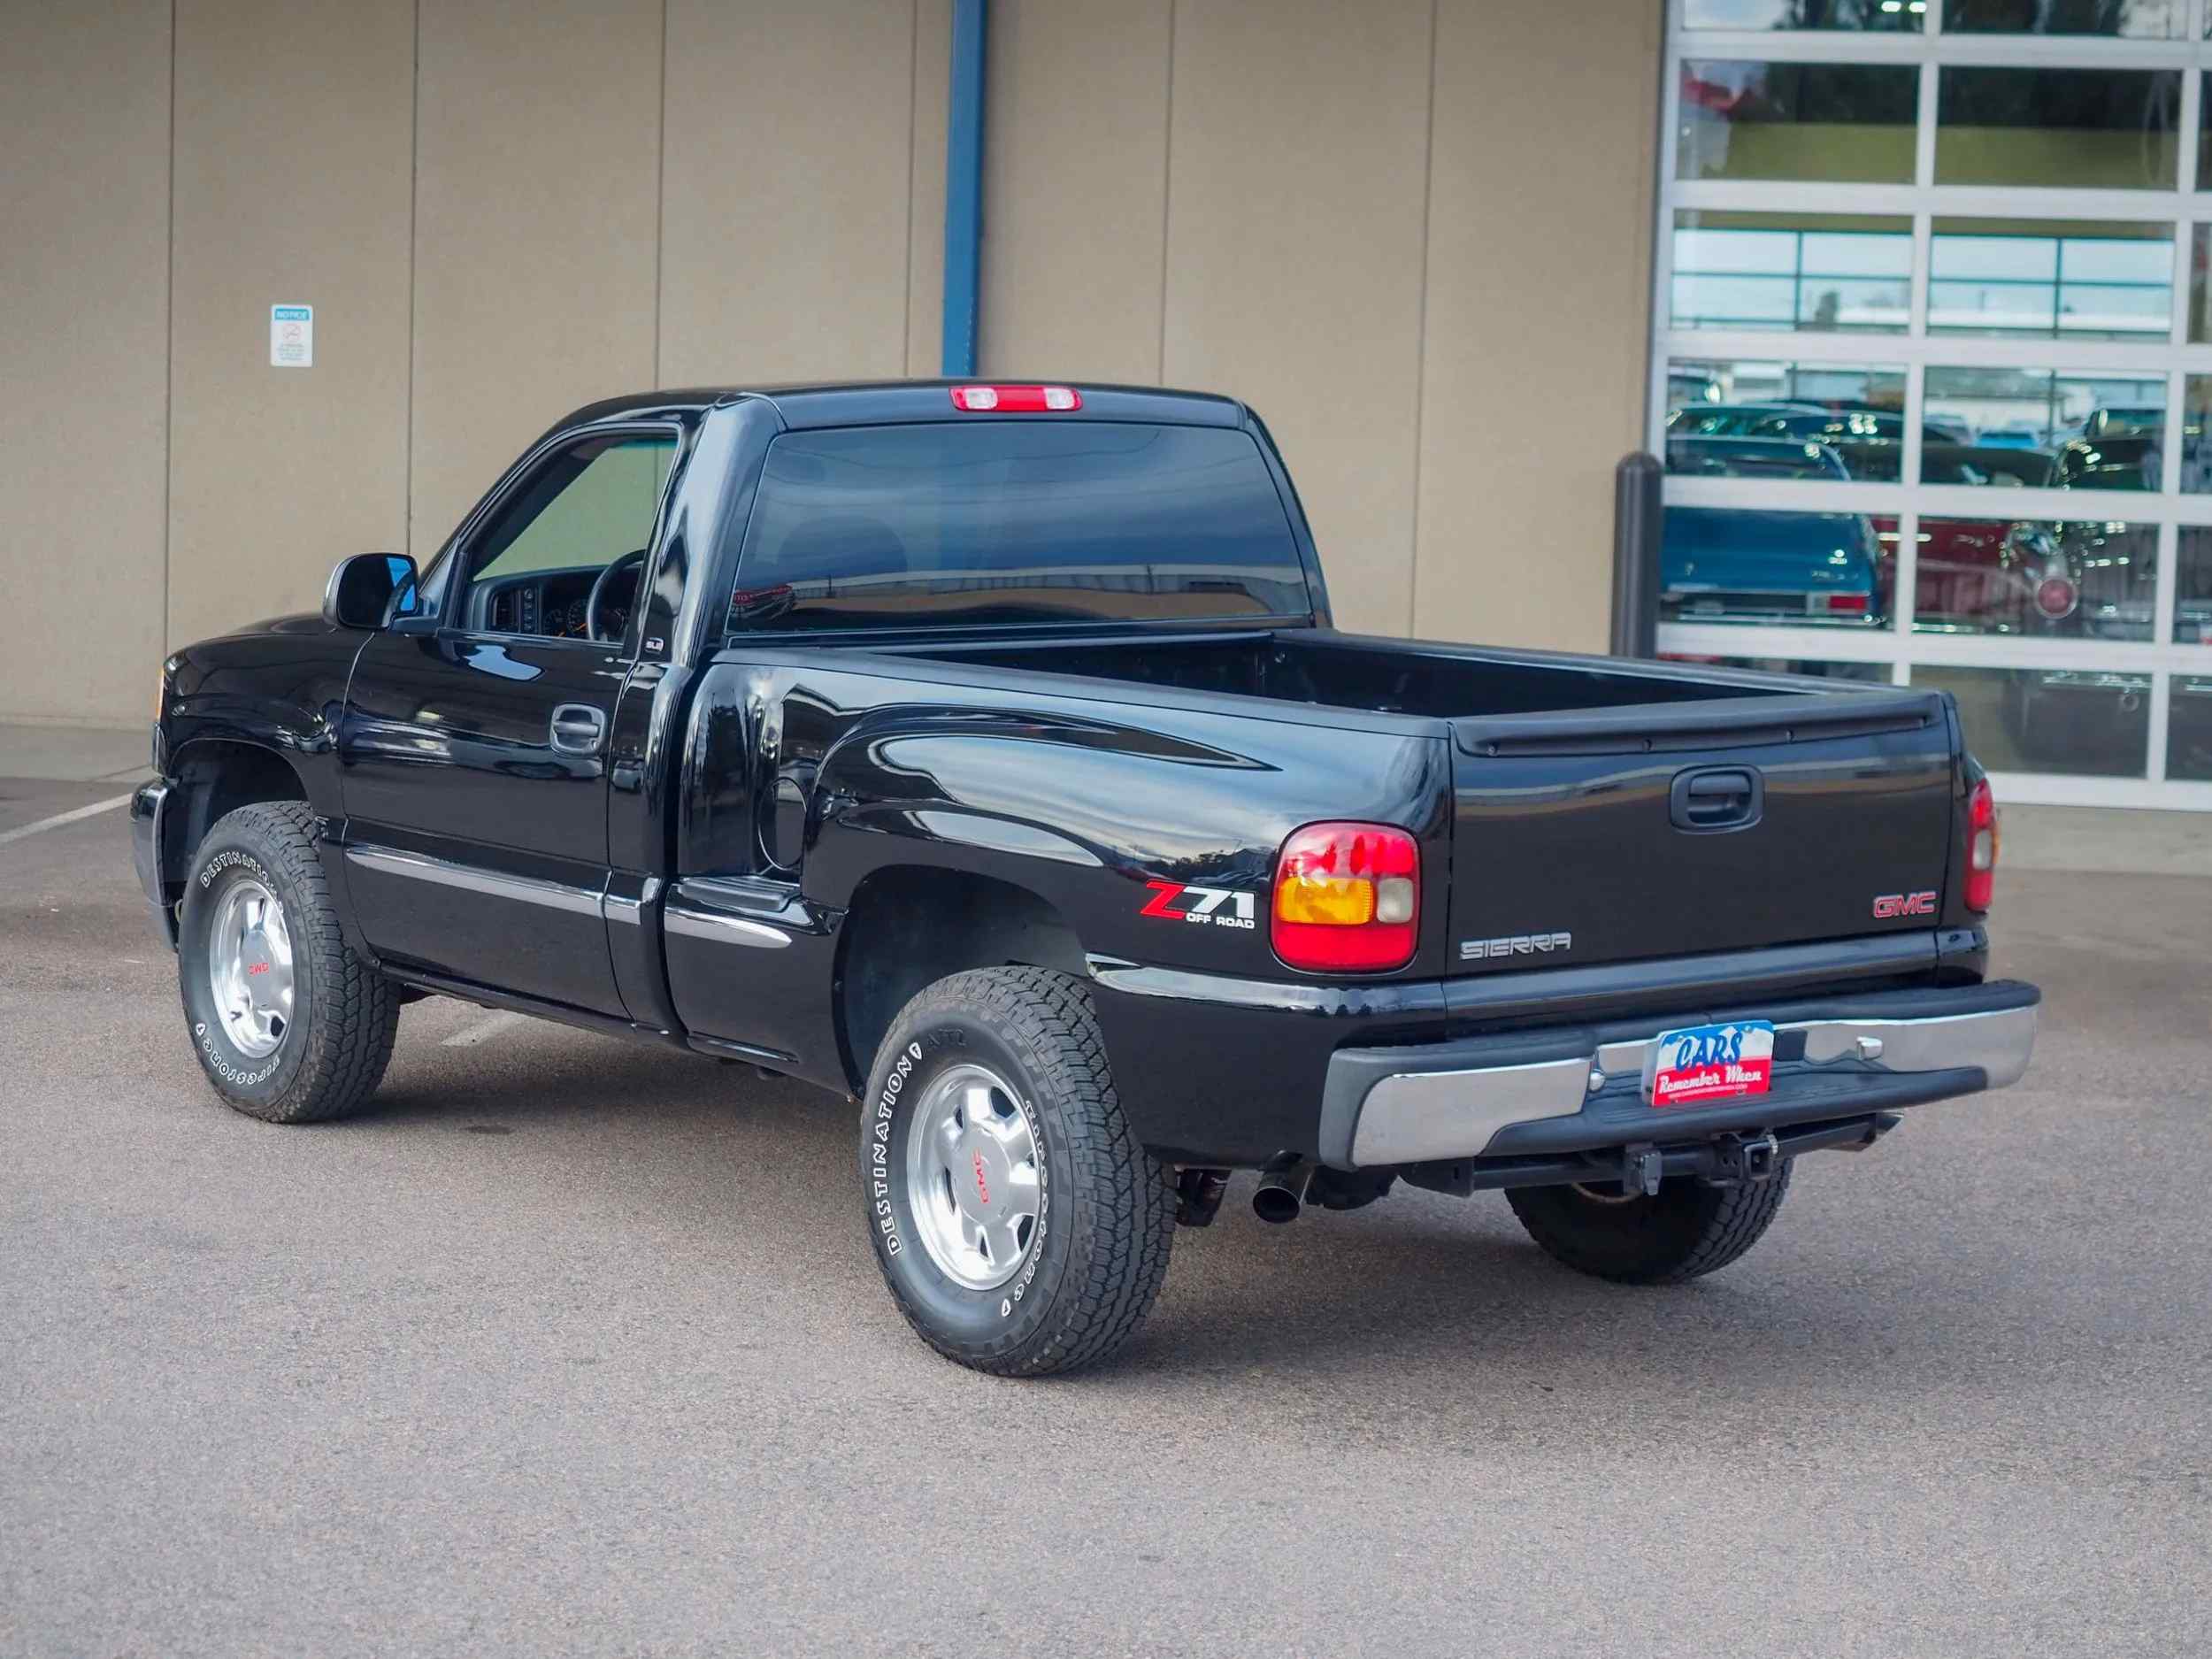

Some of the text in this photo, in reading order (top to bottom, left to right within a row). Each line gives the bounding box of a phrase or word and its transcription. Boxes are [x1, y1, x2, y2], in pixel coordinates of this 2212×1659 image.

[1141, 879, 1255, 919] Z71
[1874, 891, 1936, 918] GMC
[1186, 912, 1255, 929] OFF ROAD
[1461, 932, 1571, 960] SIERRA
[1676, 1030, 1743, 1072] CARS
[1658, 1070, 1721, 1094] Remember
[1725, 1064, 1763, 1084] When
[874, 1056, 914, 1256] DESTINATION
[972, 1148, 991, 1204] GMC
